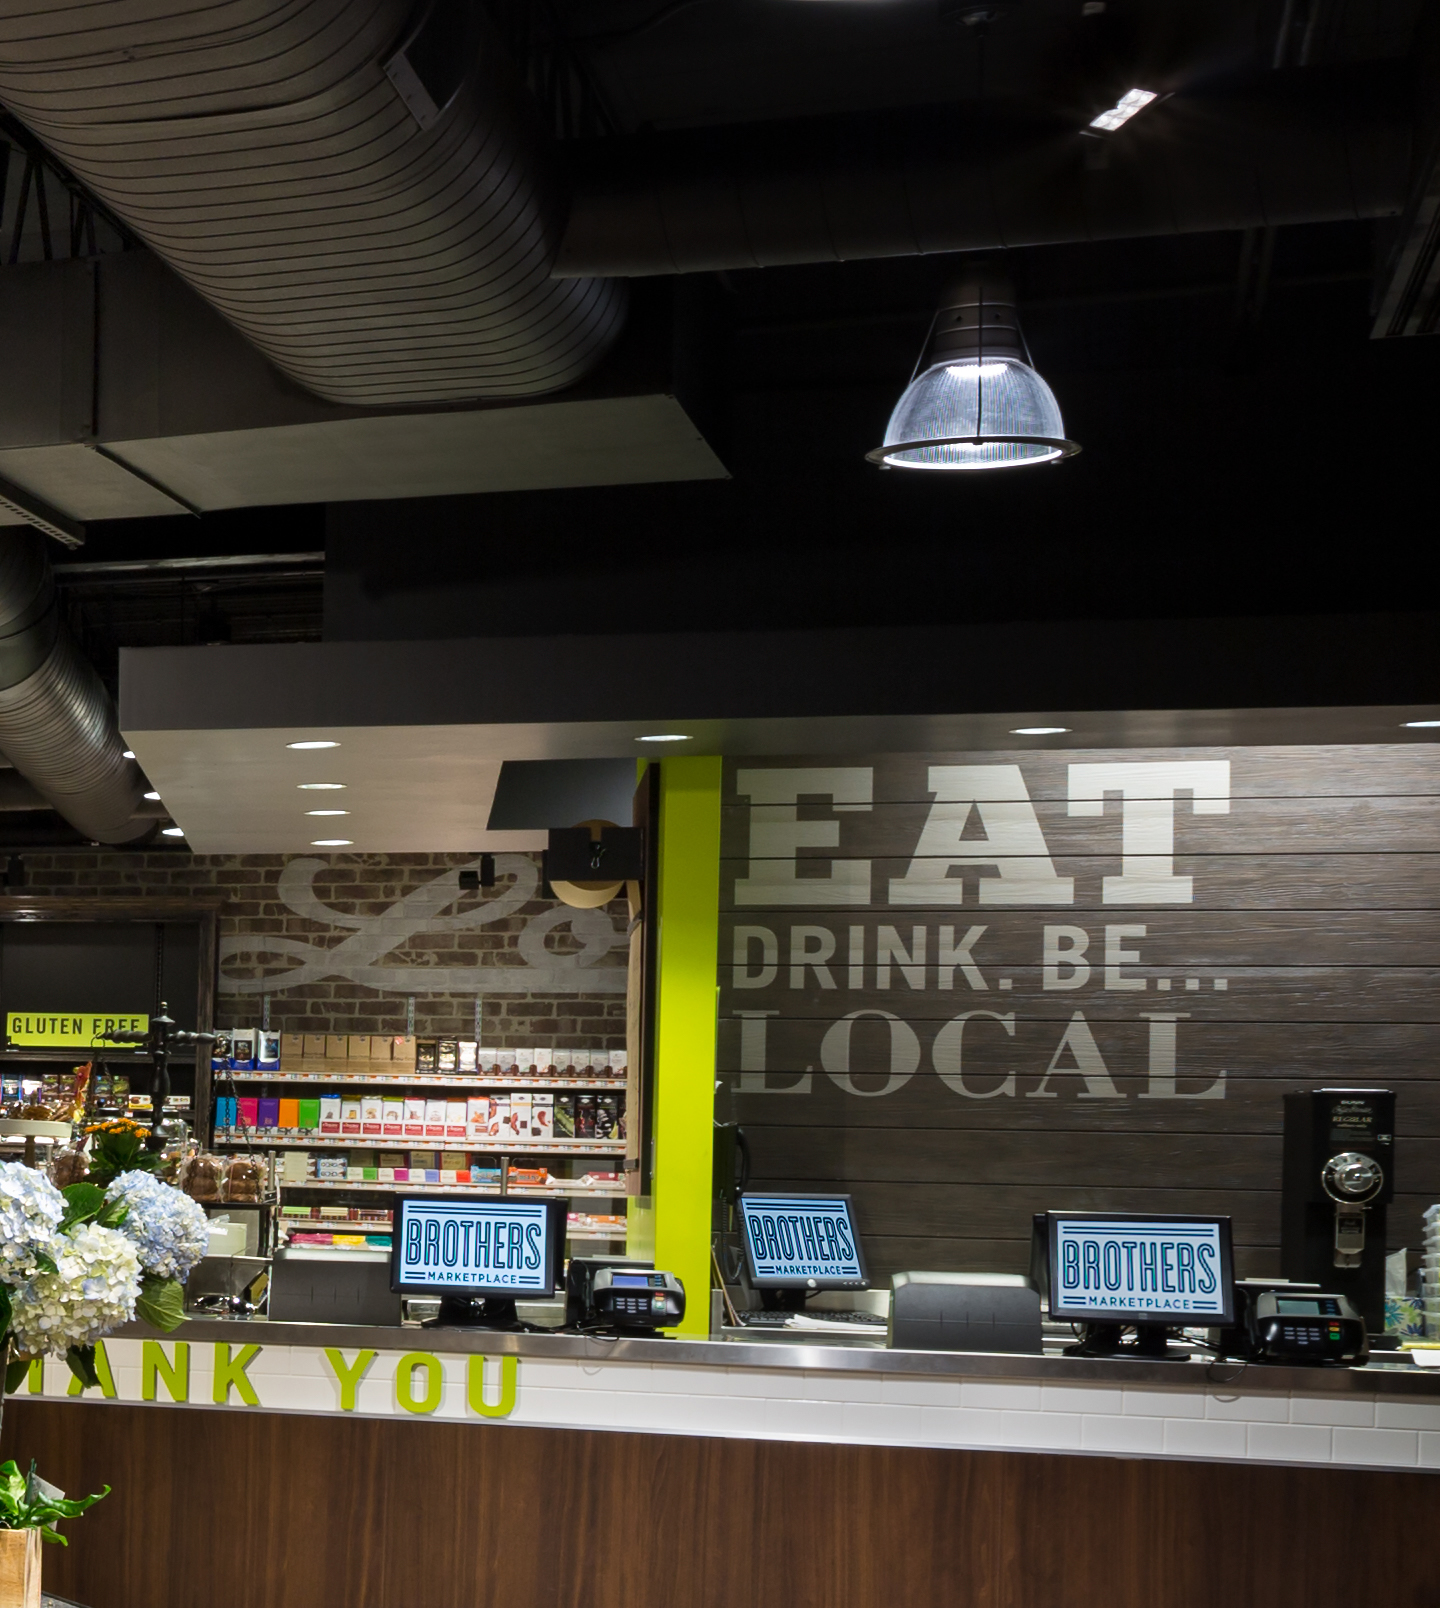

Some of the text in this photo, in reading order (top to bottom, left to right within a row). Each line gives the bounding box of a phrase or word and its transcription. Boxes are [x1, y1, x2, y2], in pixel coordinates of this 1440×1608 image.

[734, 760, 1231, 907] EAT
[733, 923, 1230, 991] DRINK. BE...
[12, 1017, 82, 1035] GLUTEN
[731, 1010, 1227, 1100] LOCAL
[406, 1218, 542, 1270] BROTHERS
[748, 1215, 854, 1261] BROTHERS
[428, 1271, 517, 1284] MARKETPLACE
[774, 1265, 842, 1275] MARKETPLACE
[1063, 1240, 1216, 1294] BROTHERS
[1089, 1296, 1190, 1309] MARKETPLACE
[324, 1348, 519, 1418] YOU
